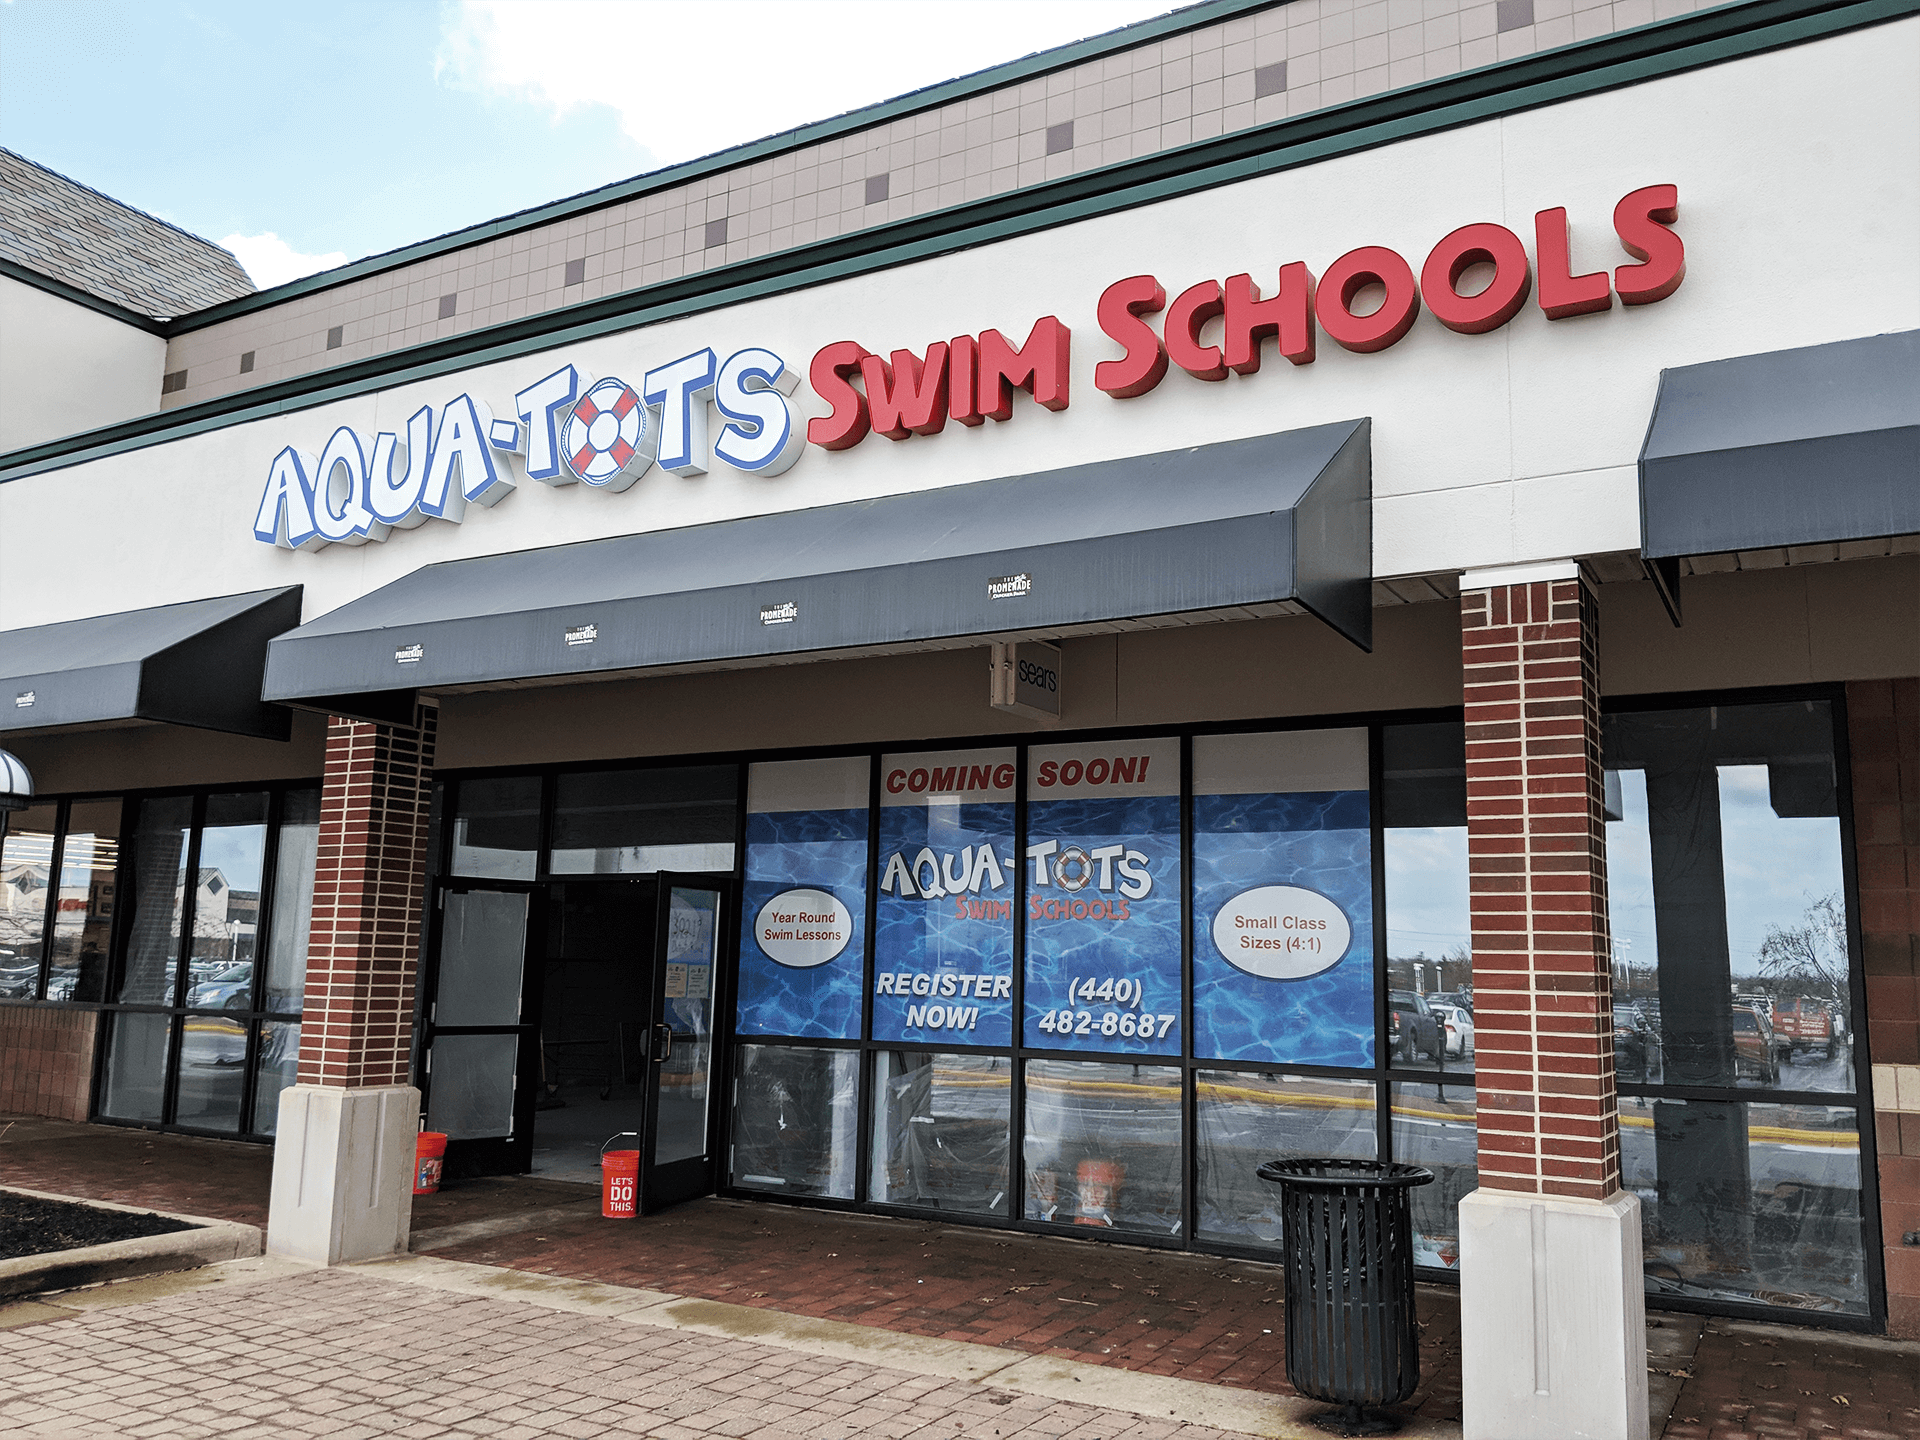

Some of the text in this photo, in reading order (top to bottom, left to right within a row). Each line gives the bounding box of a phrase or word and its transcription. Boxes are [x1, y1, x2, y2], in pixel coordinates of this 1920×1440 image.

[253, 184, 1685, 550] AQUA-TOTS SWIM SCHOOLS
[988, 580, 1031, 594] PROMENADE
[760, 607, 798, 620] PROMENADE
[1019, 660, 1057, 692] sears
[886, 756, 1150, 794] COMING SOON!
[955, 895, 1130, 920] SWIM SCHOOLS
[772, 912, 835, 923] Year Round
[1234, 915, 1327, 930] Small Class
[764, 929, 841, 940] Swim Lessons
[1240, 935, 1322, 954] Sizes (4:1)
[876, 972, 1012, 998] REGISTER
[1068, 977, 1142, 1008] (440)
[906, 1005, 979, 1030] NOW!
[1039, 1010, 1175, 1038] 482-8687
[611, 1177, 633, 1185] LET'S
[610, 1186, 632, 1201] DO
[610, 1202, 633, 1211] THIS.
